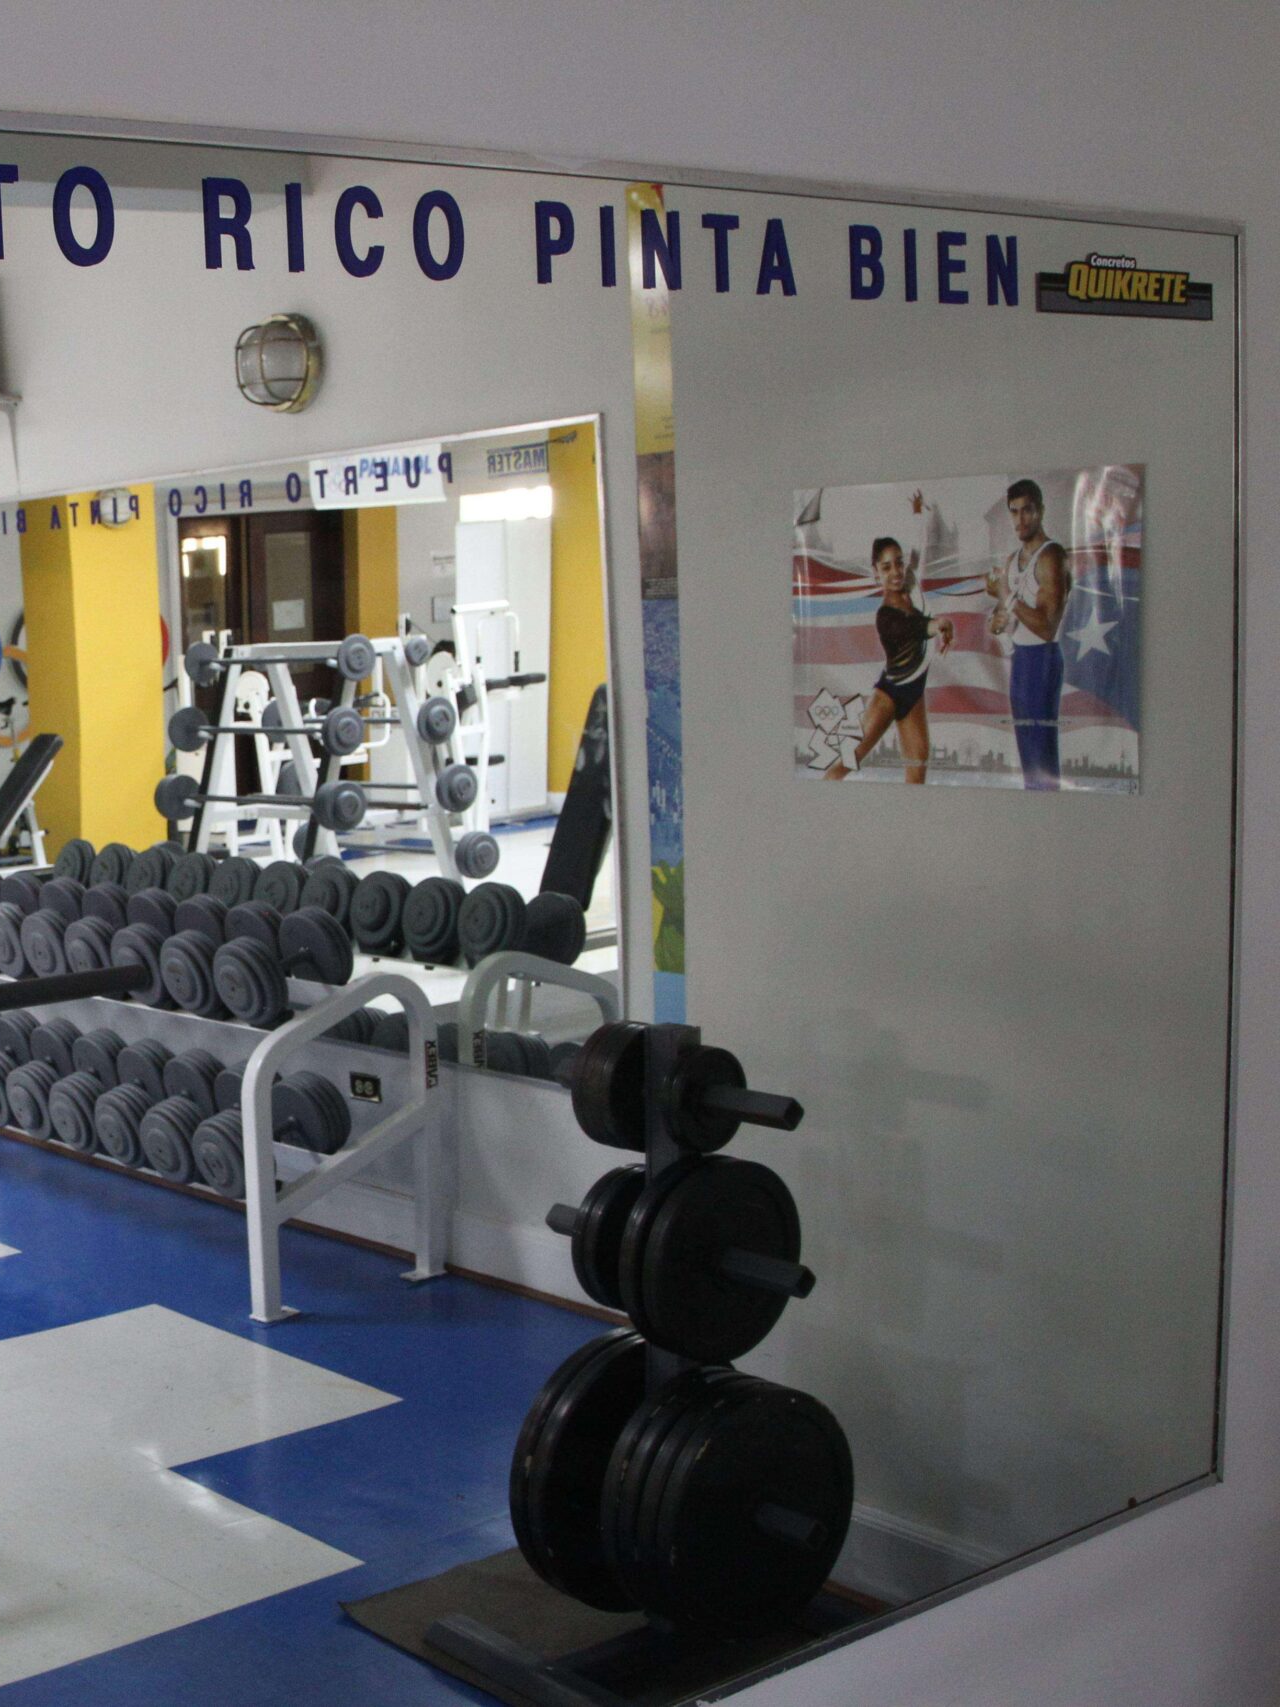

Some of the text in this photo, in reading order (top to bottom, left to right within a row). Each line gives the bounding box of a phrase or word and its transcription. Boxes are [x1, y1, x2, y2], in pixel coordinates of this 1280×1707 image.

[202, 177, 464, 281] RICO
[535, 200, 797, 296] PINTA
[848, 224, 1019, 307] BIEN
[1090, 254, 1136, 268] Concretos
[1067, 263, 1188, 304] QUIKRETE
